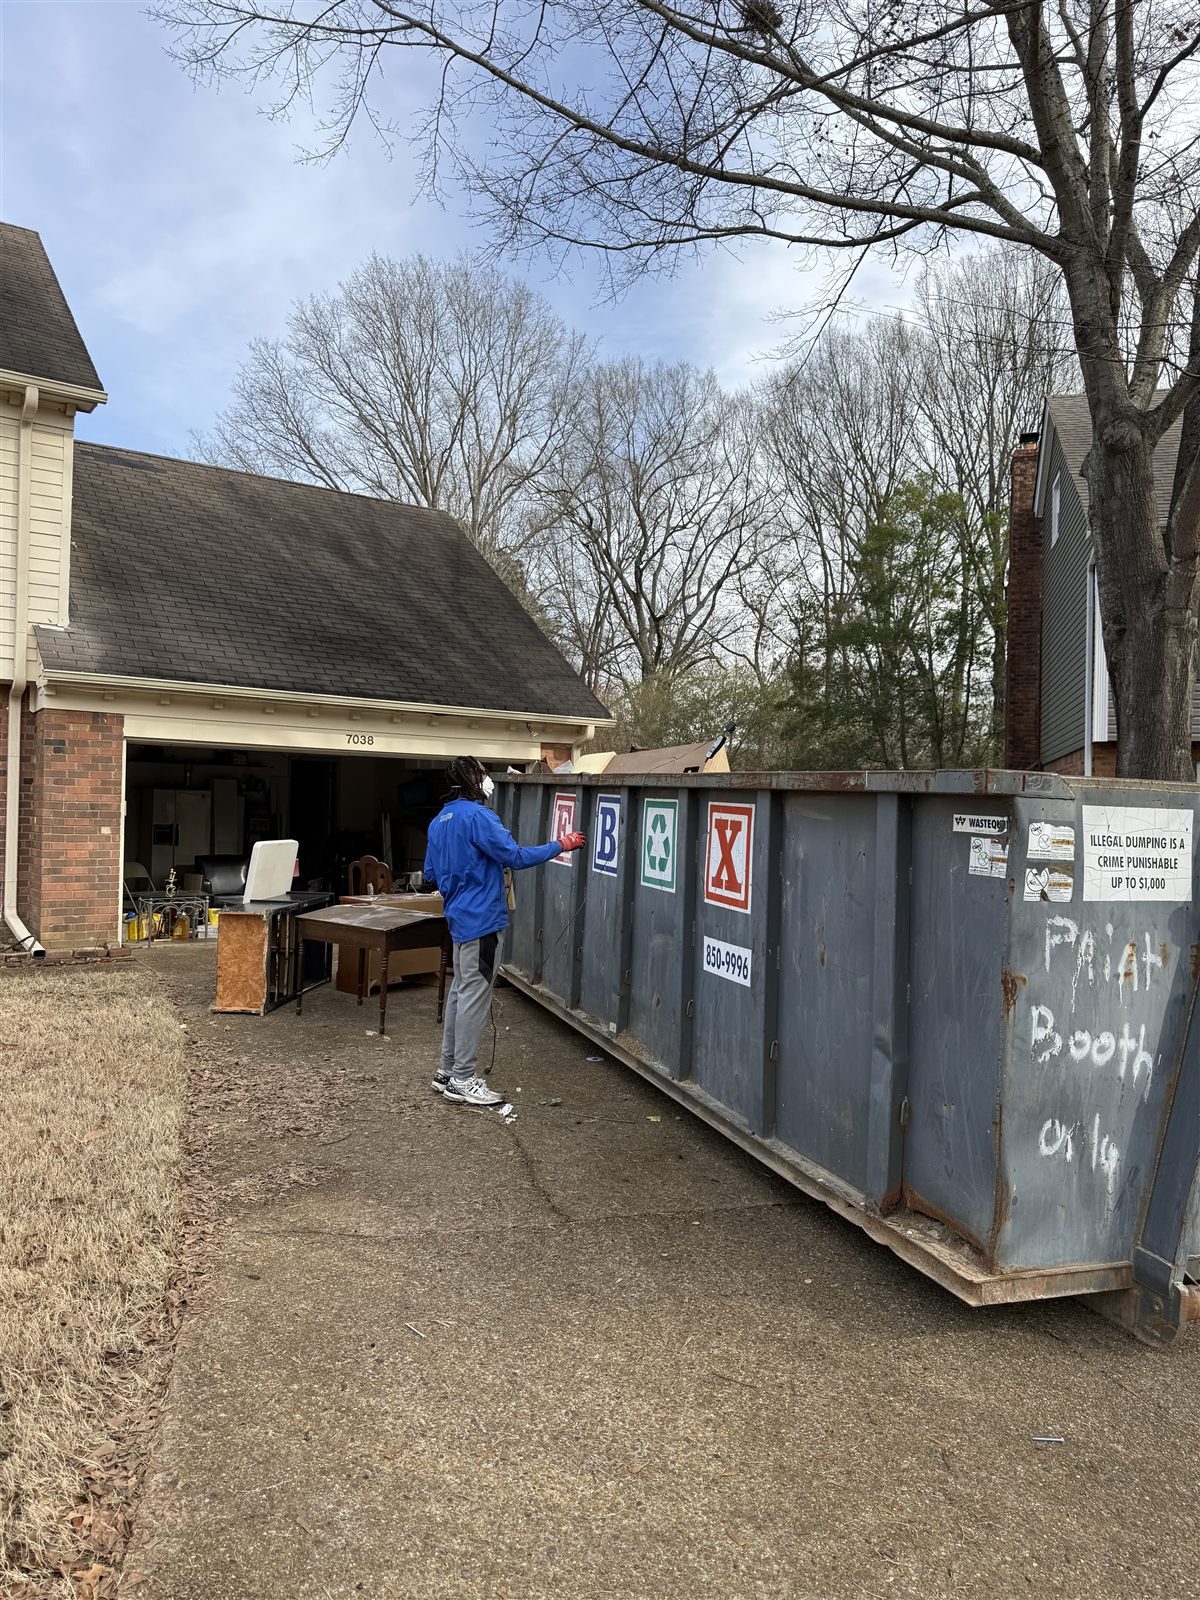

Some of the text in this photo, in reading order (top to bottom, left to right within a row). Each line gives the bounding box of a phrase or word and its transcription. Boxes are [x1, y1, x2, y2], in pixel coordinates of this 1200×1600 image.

[345, 734, 374, 746] 7038
[597, 805, 617, 862] B
[711, 818, 743, 893] X
[1090, 835, 1185, 850] ILLEGAL DUMPING IS A
[1097, 855, 1178, 869] CRIME PUNISHABLE
[1111, 876, 1166, 891] UP TO $1,000
[705, 943, 749, 981] 850-9996
[1030, 1003, 1153, 1098] Booth
